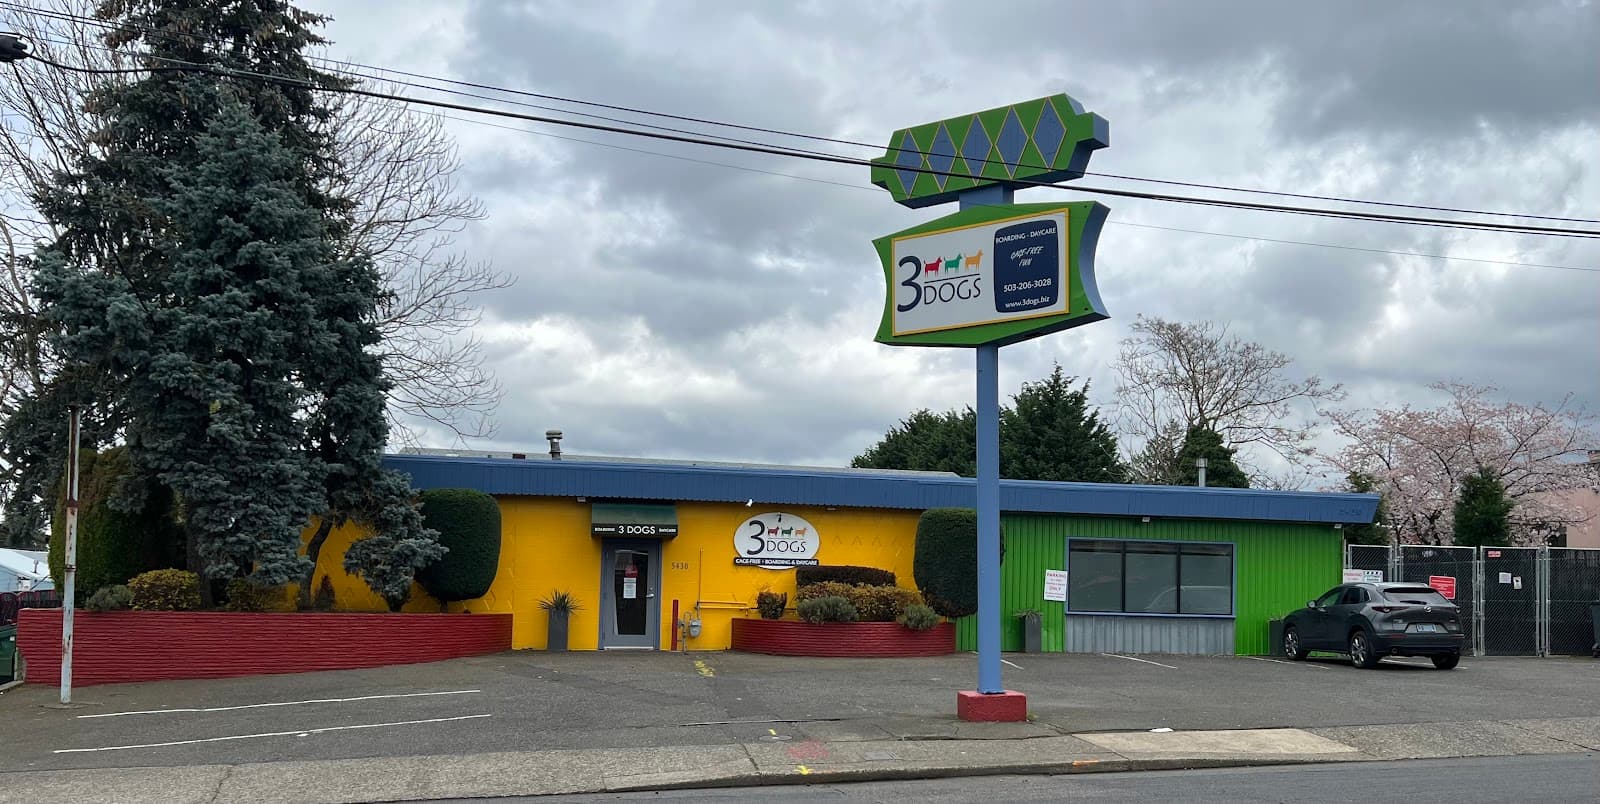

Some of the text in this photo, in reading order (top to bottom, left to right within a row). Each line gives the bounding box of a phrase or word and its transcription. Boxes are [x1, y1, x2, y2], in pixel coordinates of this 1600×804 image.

[996, 232, 1026, 244] BOARDING
[1030, 228, 1056, 238] DAYCARE
[1010, 246, 1044, 259] CAGE-FREE
[1018, 258, 1033, 268] FUN
[897, 256, 981, 312] 3 DOGS
[1003, 278, 1052, 292] 503-206-3028
[1005, 296, 1050, 308] www.3dogs.biz
[618, 525, 625, 534] 3
[627, 525, 656, 534] DOGS
[747, 519, 806, 555] 3 DOGS
